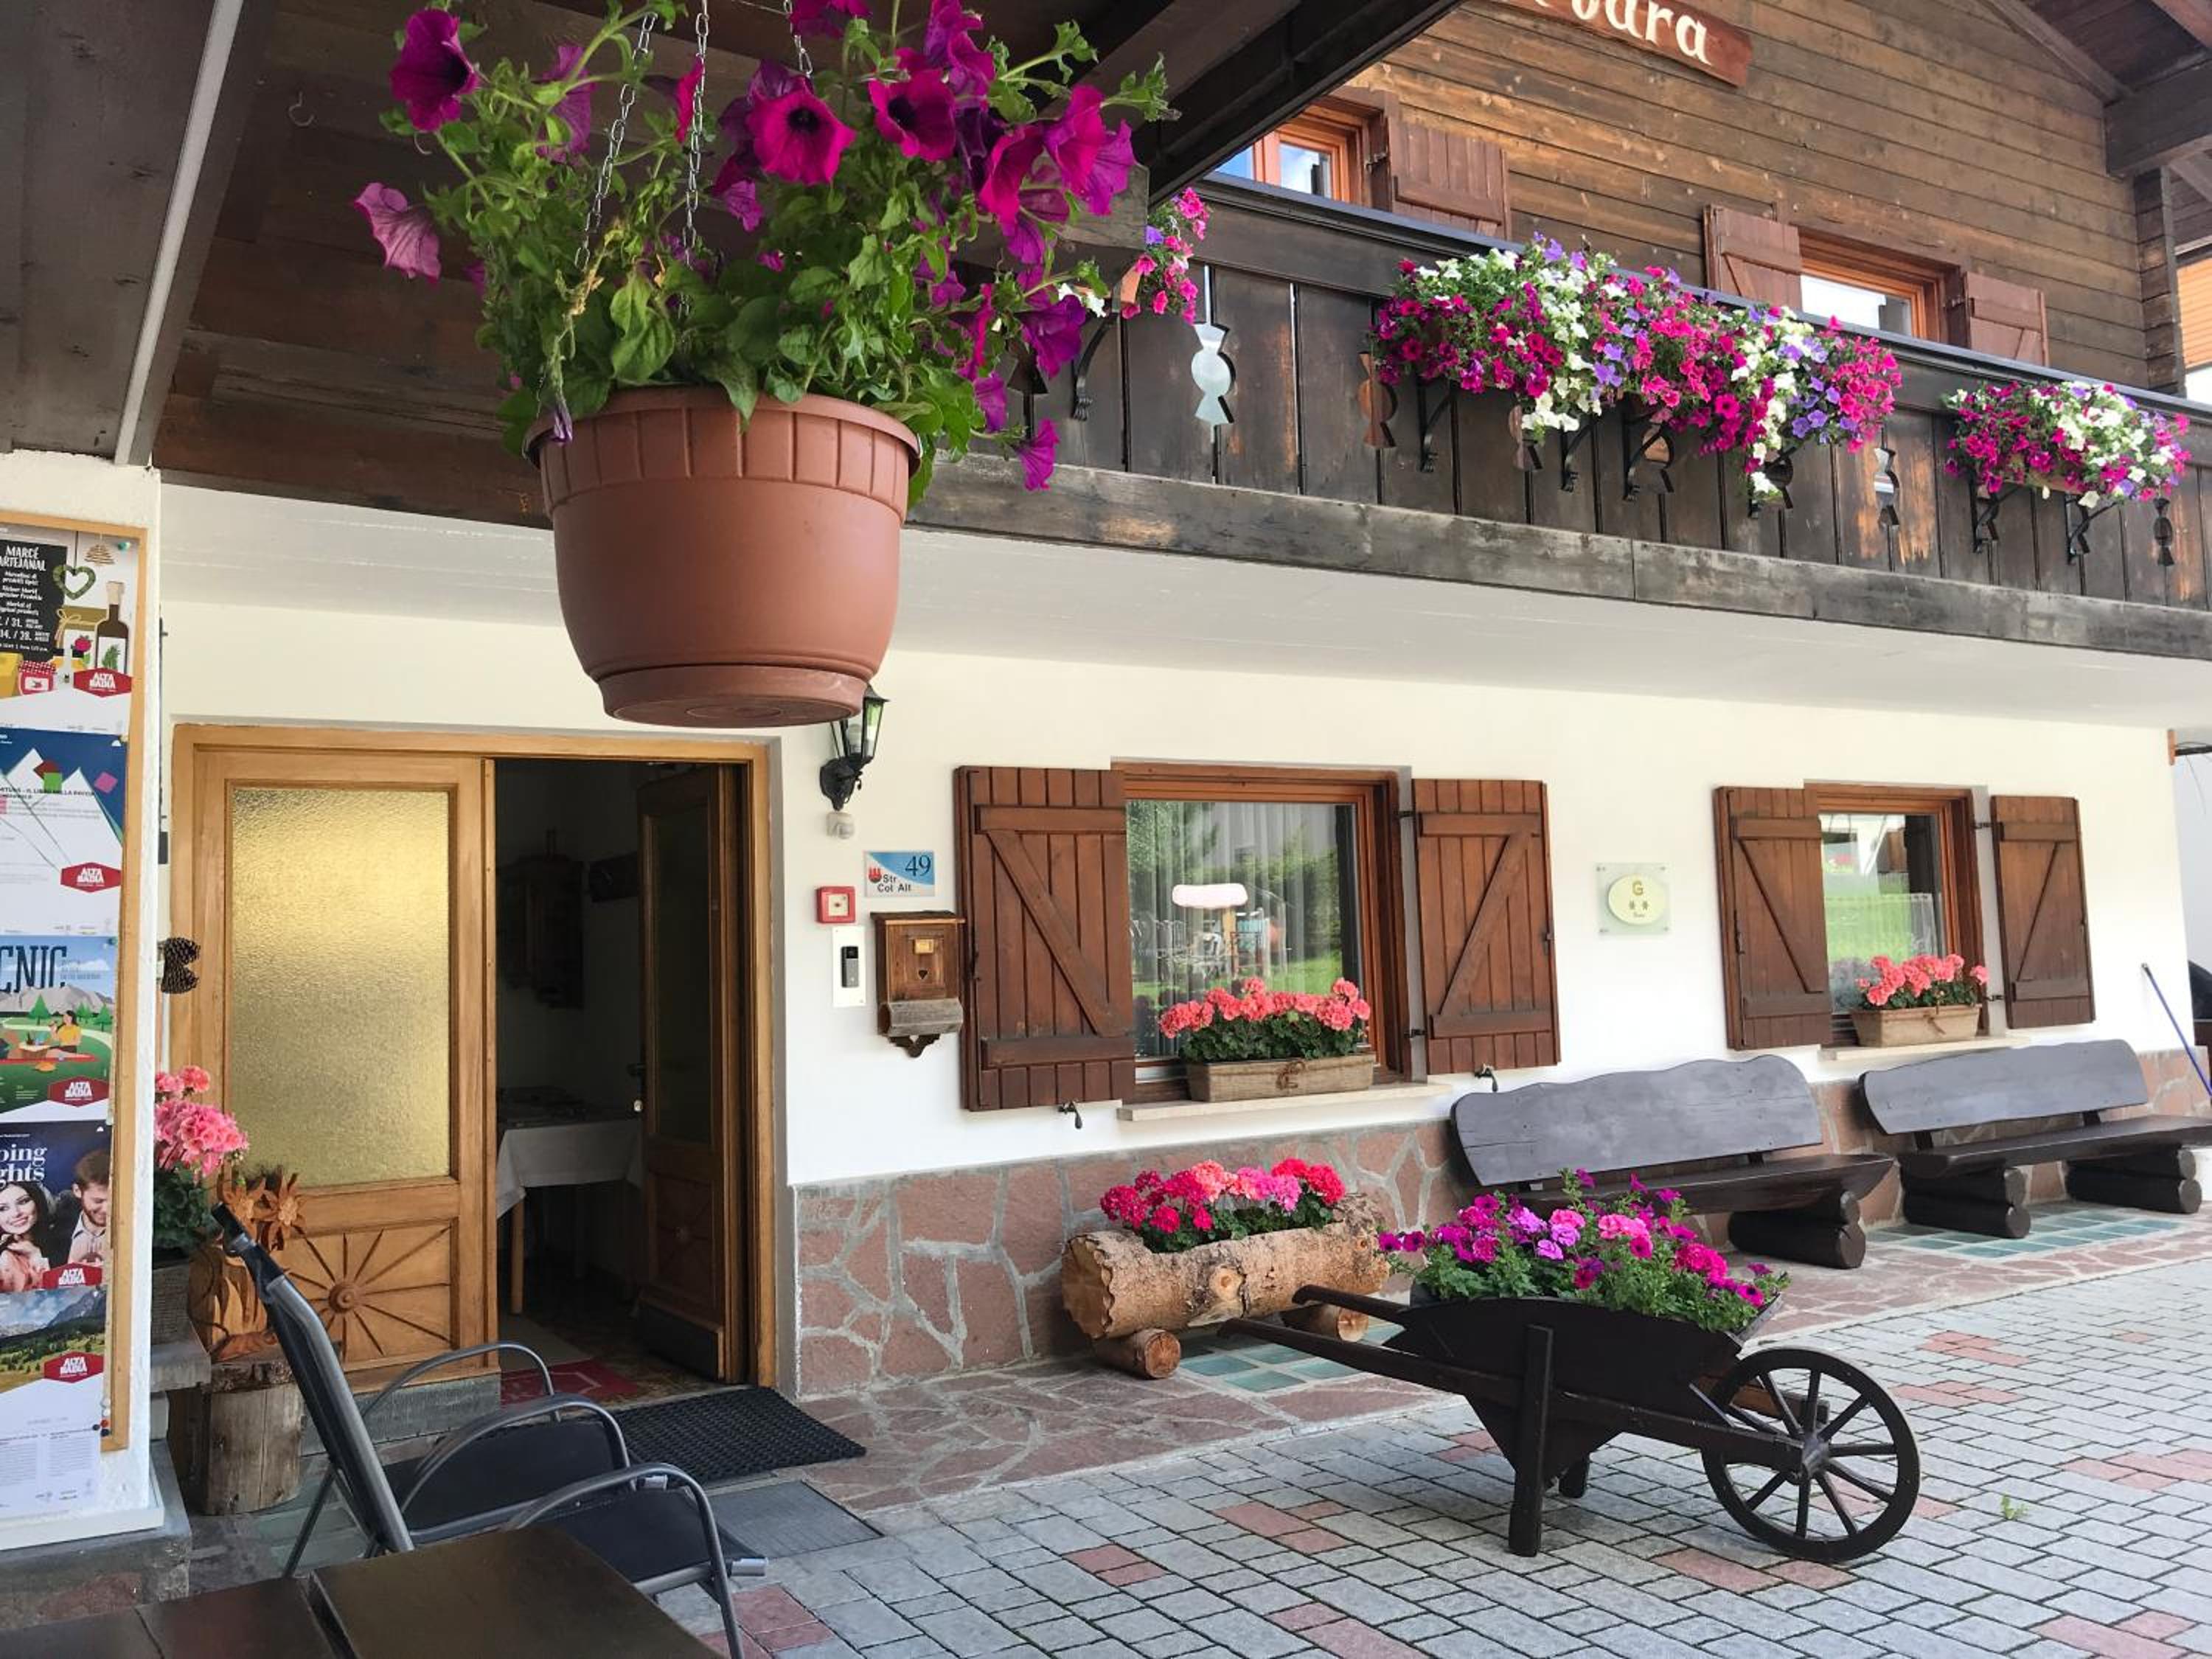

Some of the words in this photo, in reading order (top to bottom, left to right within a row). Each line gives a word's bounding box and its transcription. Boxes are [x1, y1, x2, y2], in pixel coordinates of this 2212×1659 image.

[1534, 0, 1712, 65] ara
[905, 855, 931, 877] 49
[877, 883, 894, 893] Col
[0, 945, 67, 993] CNIC
